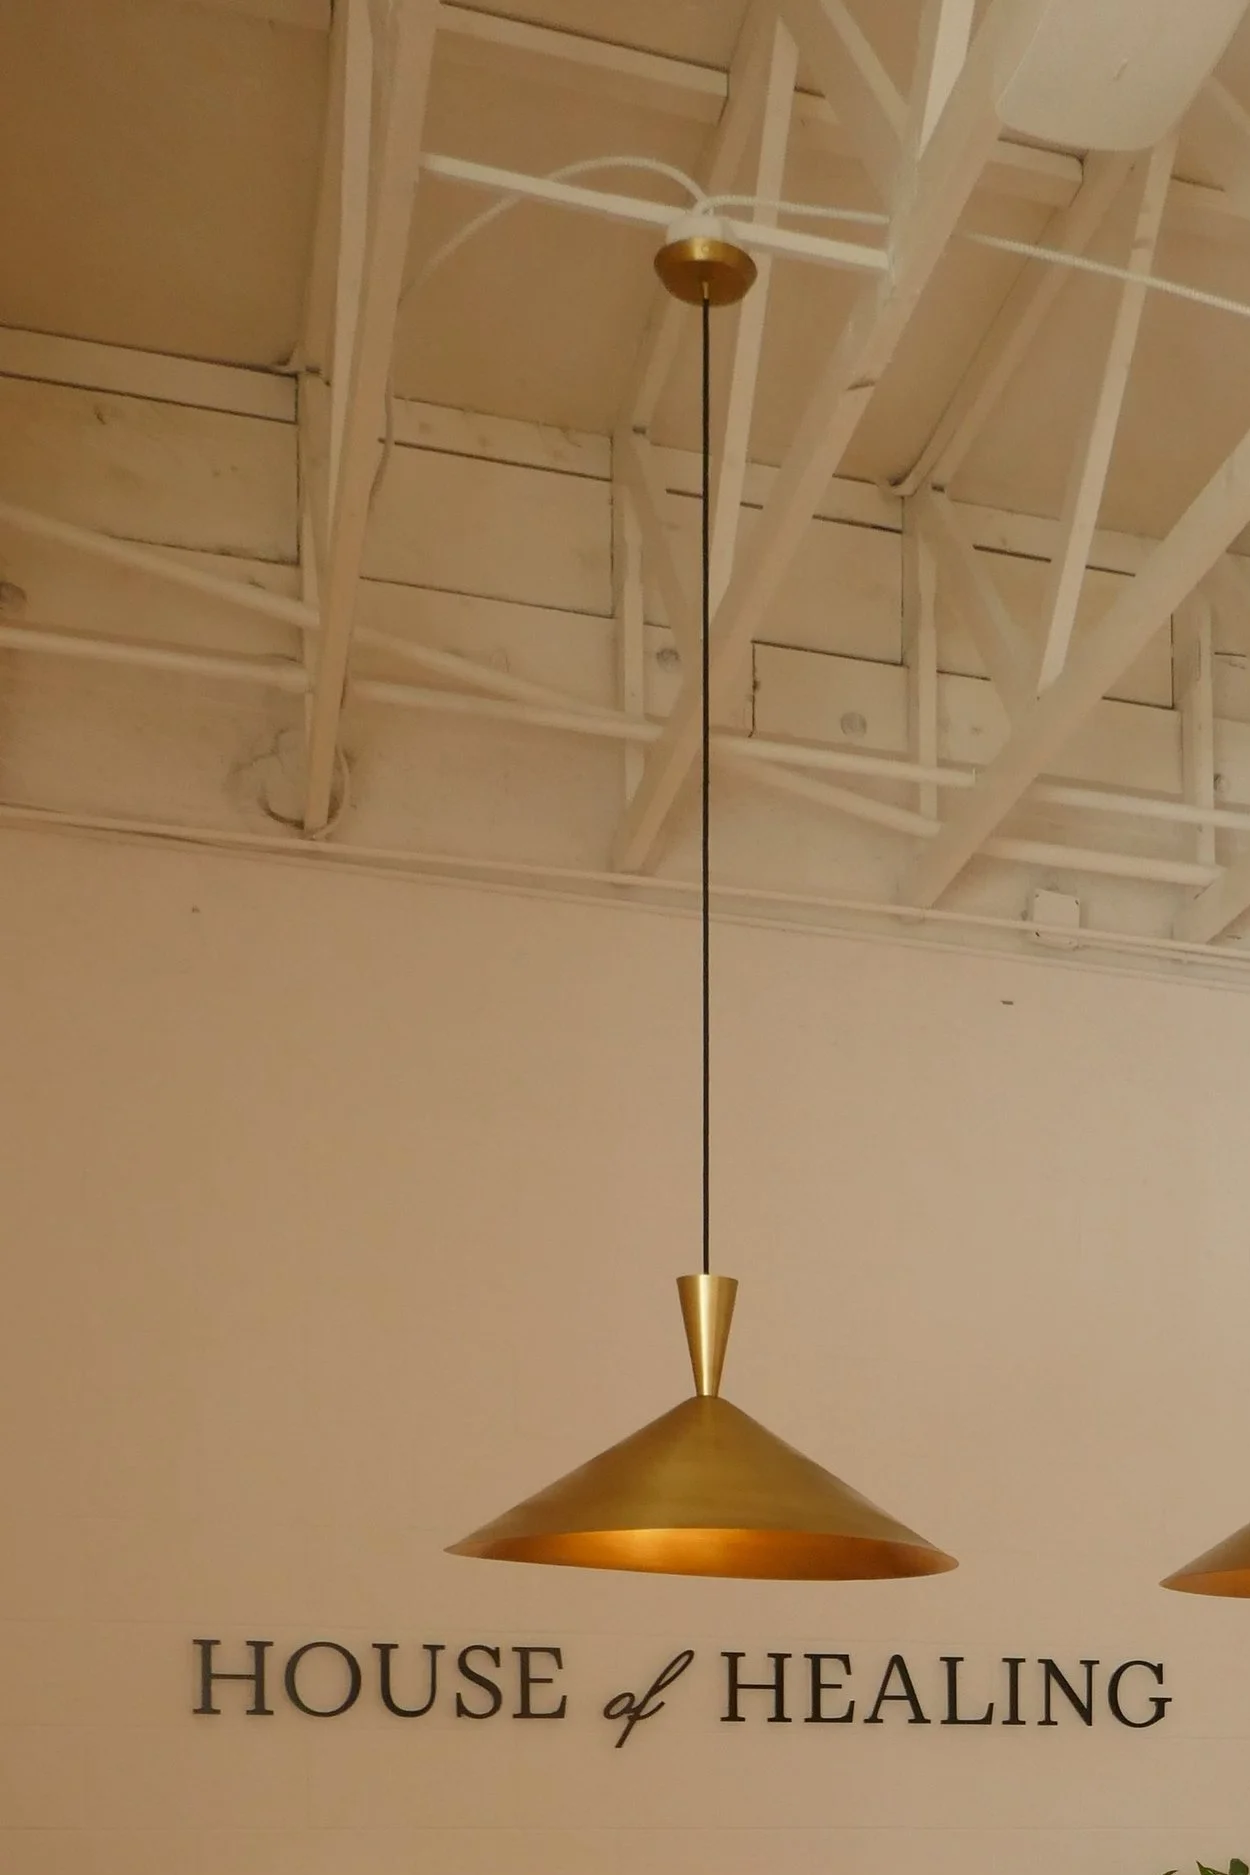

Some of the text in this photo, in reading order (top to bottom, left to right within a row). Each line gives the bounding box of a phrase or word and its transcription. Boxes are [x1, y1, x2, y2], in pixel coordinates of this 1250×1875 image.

[191, 1638, 1173, 1749] HOUSE of HEALING
